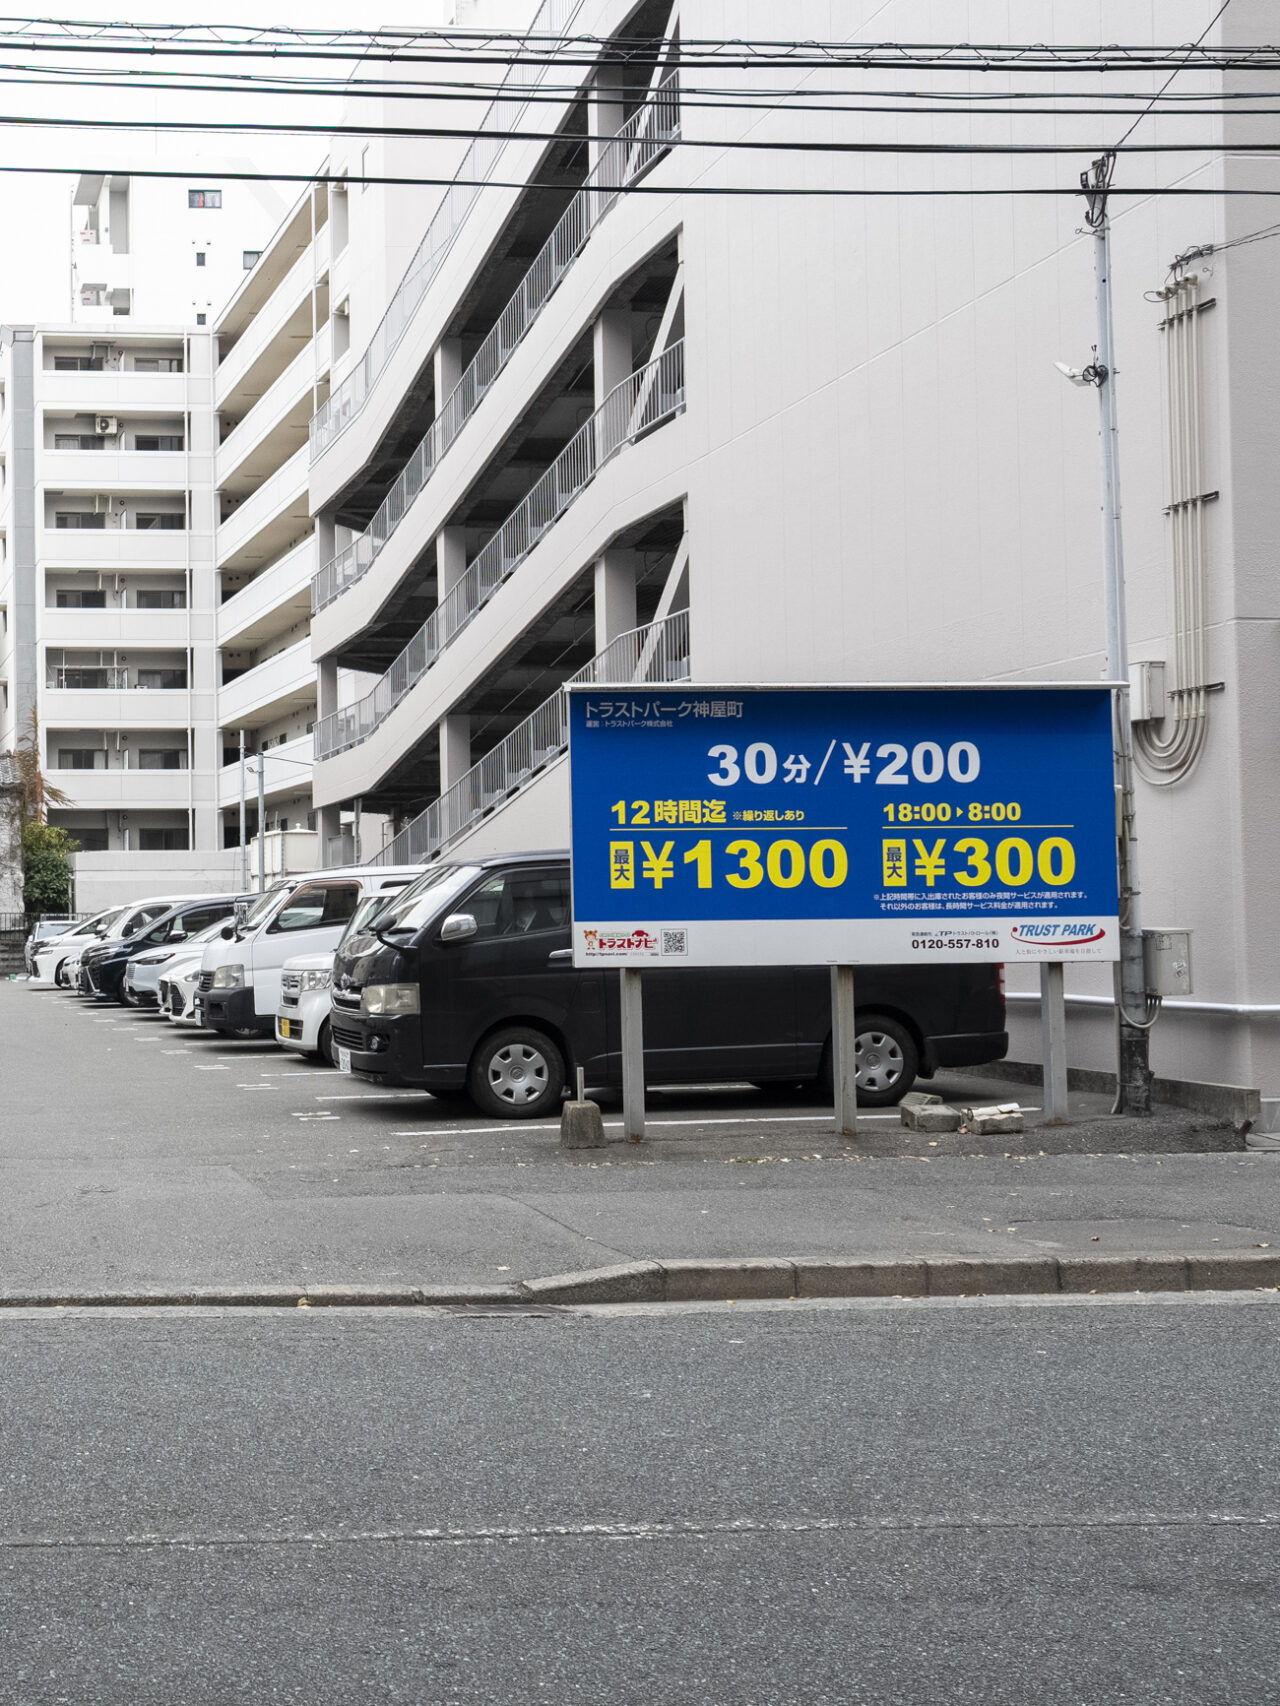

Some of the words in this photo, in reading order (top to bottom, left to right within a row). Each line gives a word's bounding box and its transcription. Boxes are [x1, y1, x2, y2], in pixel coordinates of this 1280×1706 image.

[586, 701, 744, 718] トラストパーク神屋町
[611, 799, 726, 824] 12時間迄
[614, 849, 631, 882] 最大
[640, 839, 849, 889] ¥1300
[886, 847, 903, 879] 最大
[912, 837, 1076, 887] ¥300
[1019, 924, 1060, 936] TRUST
[1062, 923, 1096, 936] PARK
[599, 938, 659, 949] トラストナビ
[912, 939, 999, 949] 0120-557-810
